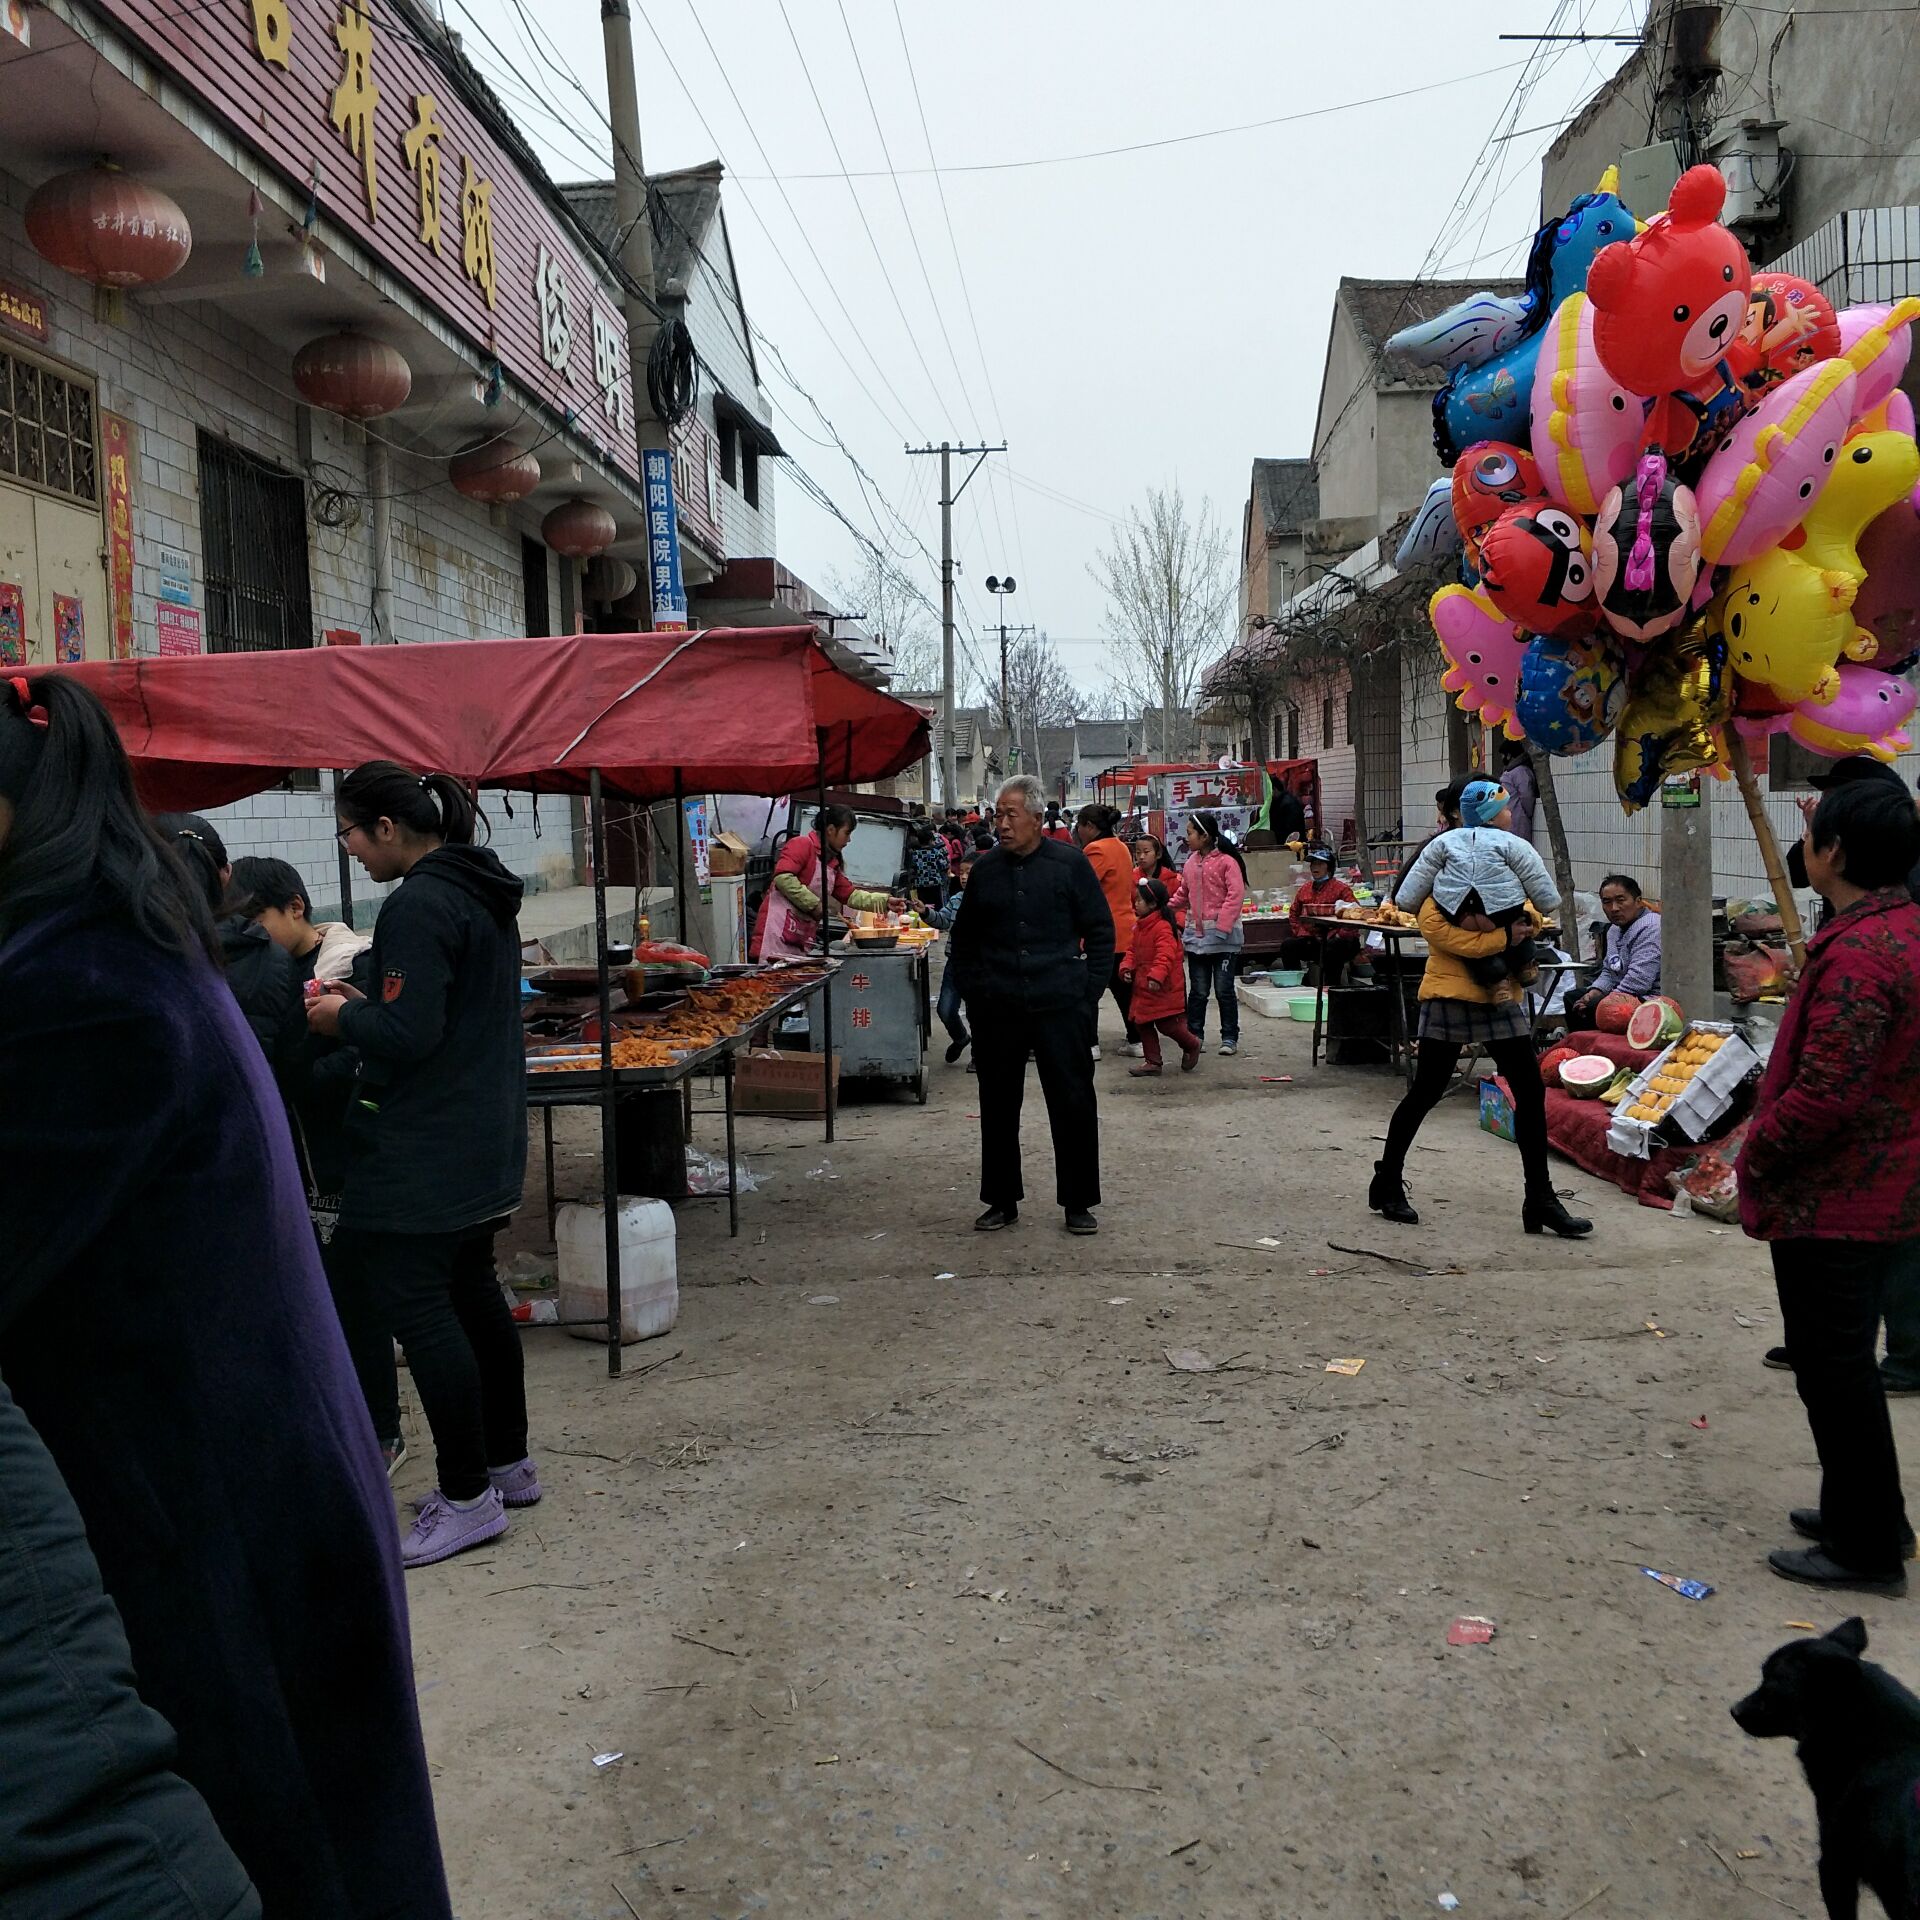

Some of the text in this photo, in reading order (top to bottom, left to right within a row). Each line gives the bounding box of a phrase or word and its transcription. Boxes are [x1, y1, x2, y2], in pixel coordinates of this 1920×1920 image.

[647, 455, 674, 613] 朝阳医院男科
[851, 973, 872, 1028] 牛排
